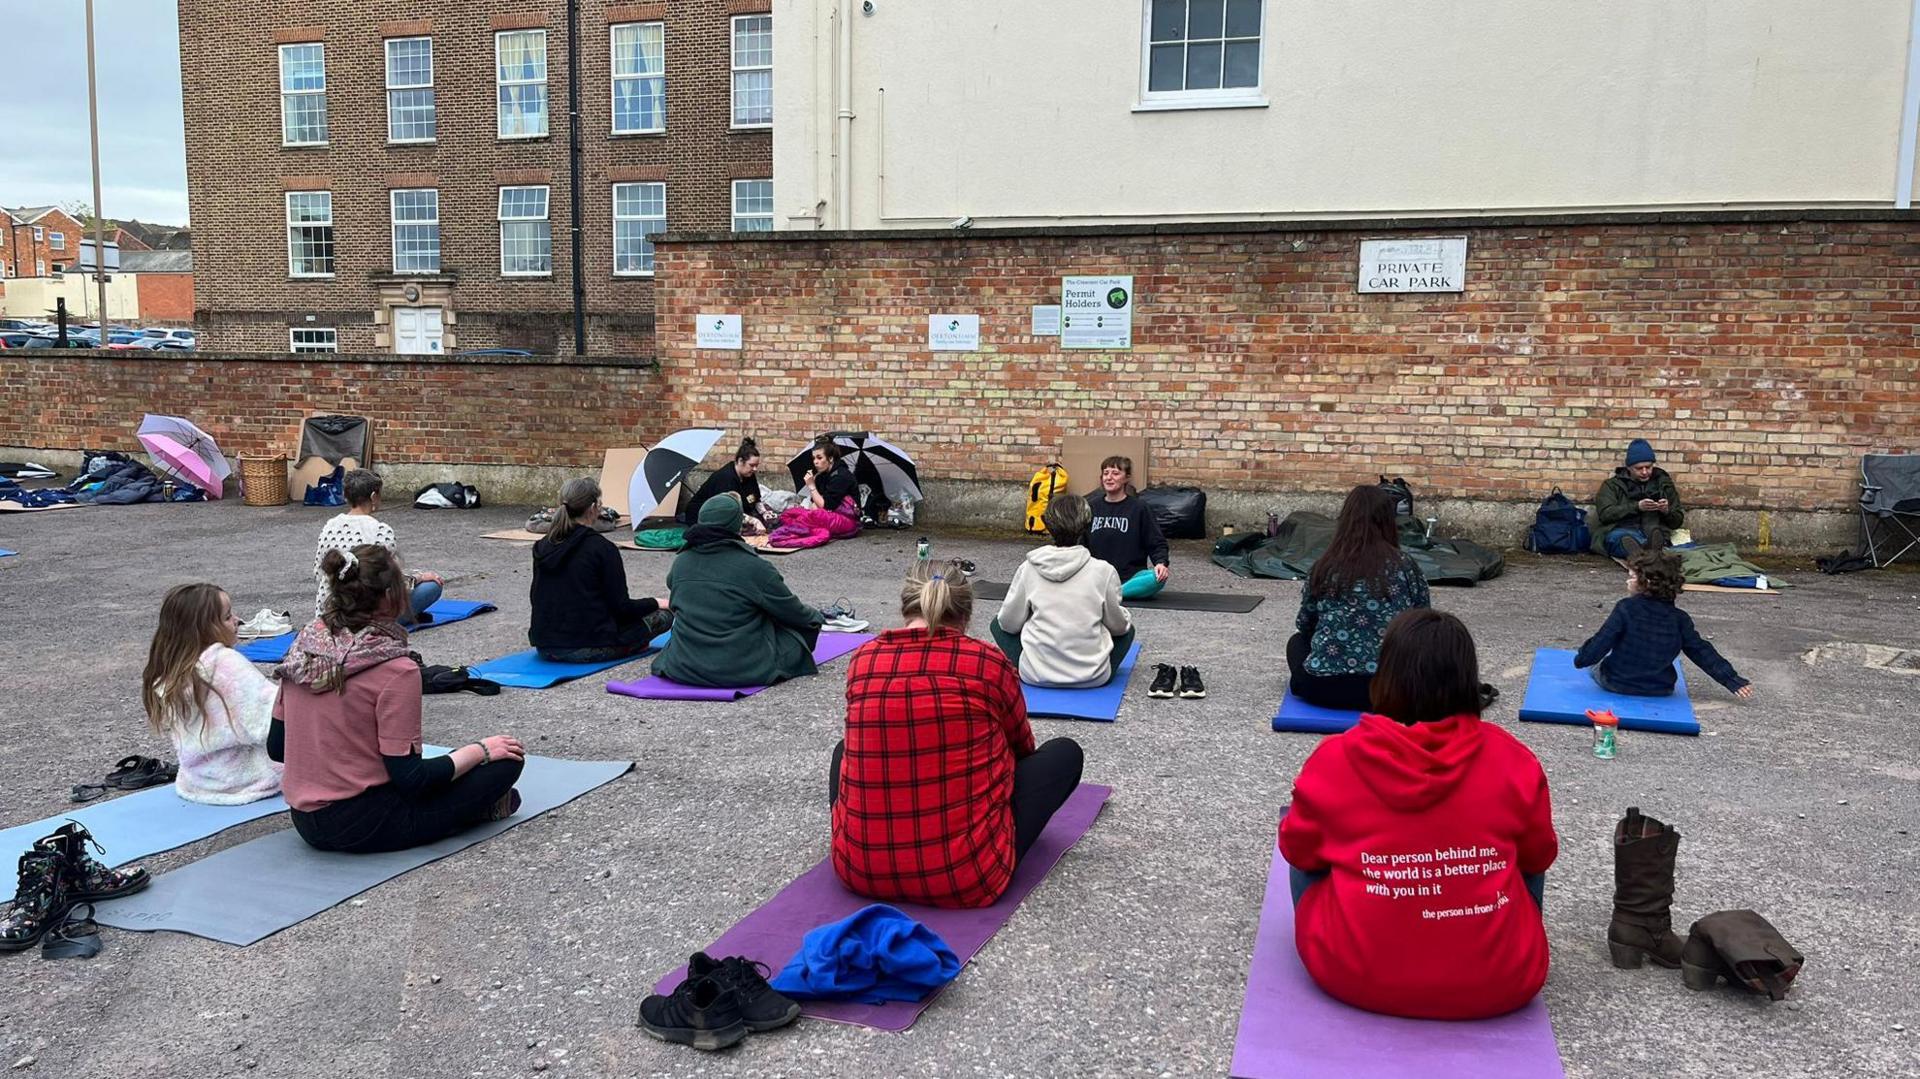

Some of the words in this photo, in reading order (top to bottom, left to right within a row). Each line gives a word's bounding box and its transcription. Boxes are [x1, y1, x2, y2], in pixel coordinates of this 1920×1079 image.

[1377, 262, 1444, 274] PRIVATE
[1368, 277, 1400, 289] CAR
[1408, 276, 1452, 288] PARK
[1065, 289, 1096, 298] Permit
[1065, 300, 1102, 308] Holders
[1091, 516, 1104, 533] BE
[1104, 516, 1129, 533] KIND
[1360, 852, 1389, 865] Dear
[1391, 853, 1433, 867] person
[1435, 846, 1477, 862] behind
[1384, 867, 1419, 880] world
[1422, 868, 1432, 879] is
[1434, 869, 1442, 878] a
[1444, 864, 1481, 876] better
[1482, 859, 1507, 875] place
[1366, 883, 1390, 896] with
[1392, 886, 1415, 899] you
[1418, 884, 1431, 896] in
[1433, 883, 1443, 895] it
[1422, 909, 1436, 919] the
[1436, 908, 1464, 920] person
[1465, 906, 1473, 915] in
[1474, 904, 1494, 915] front
